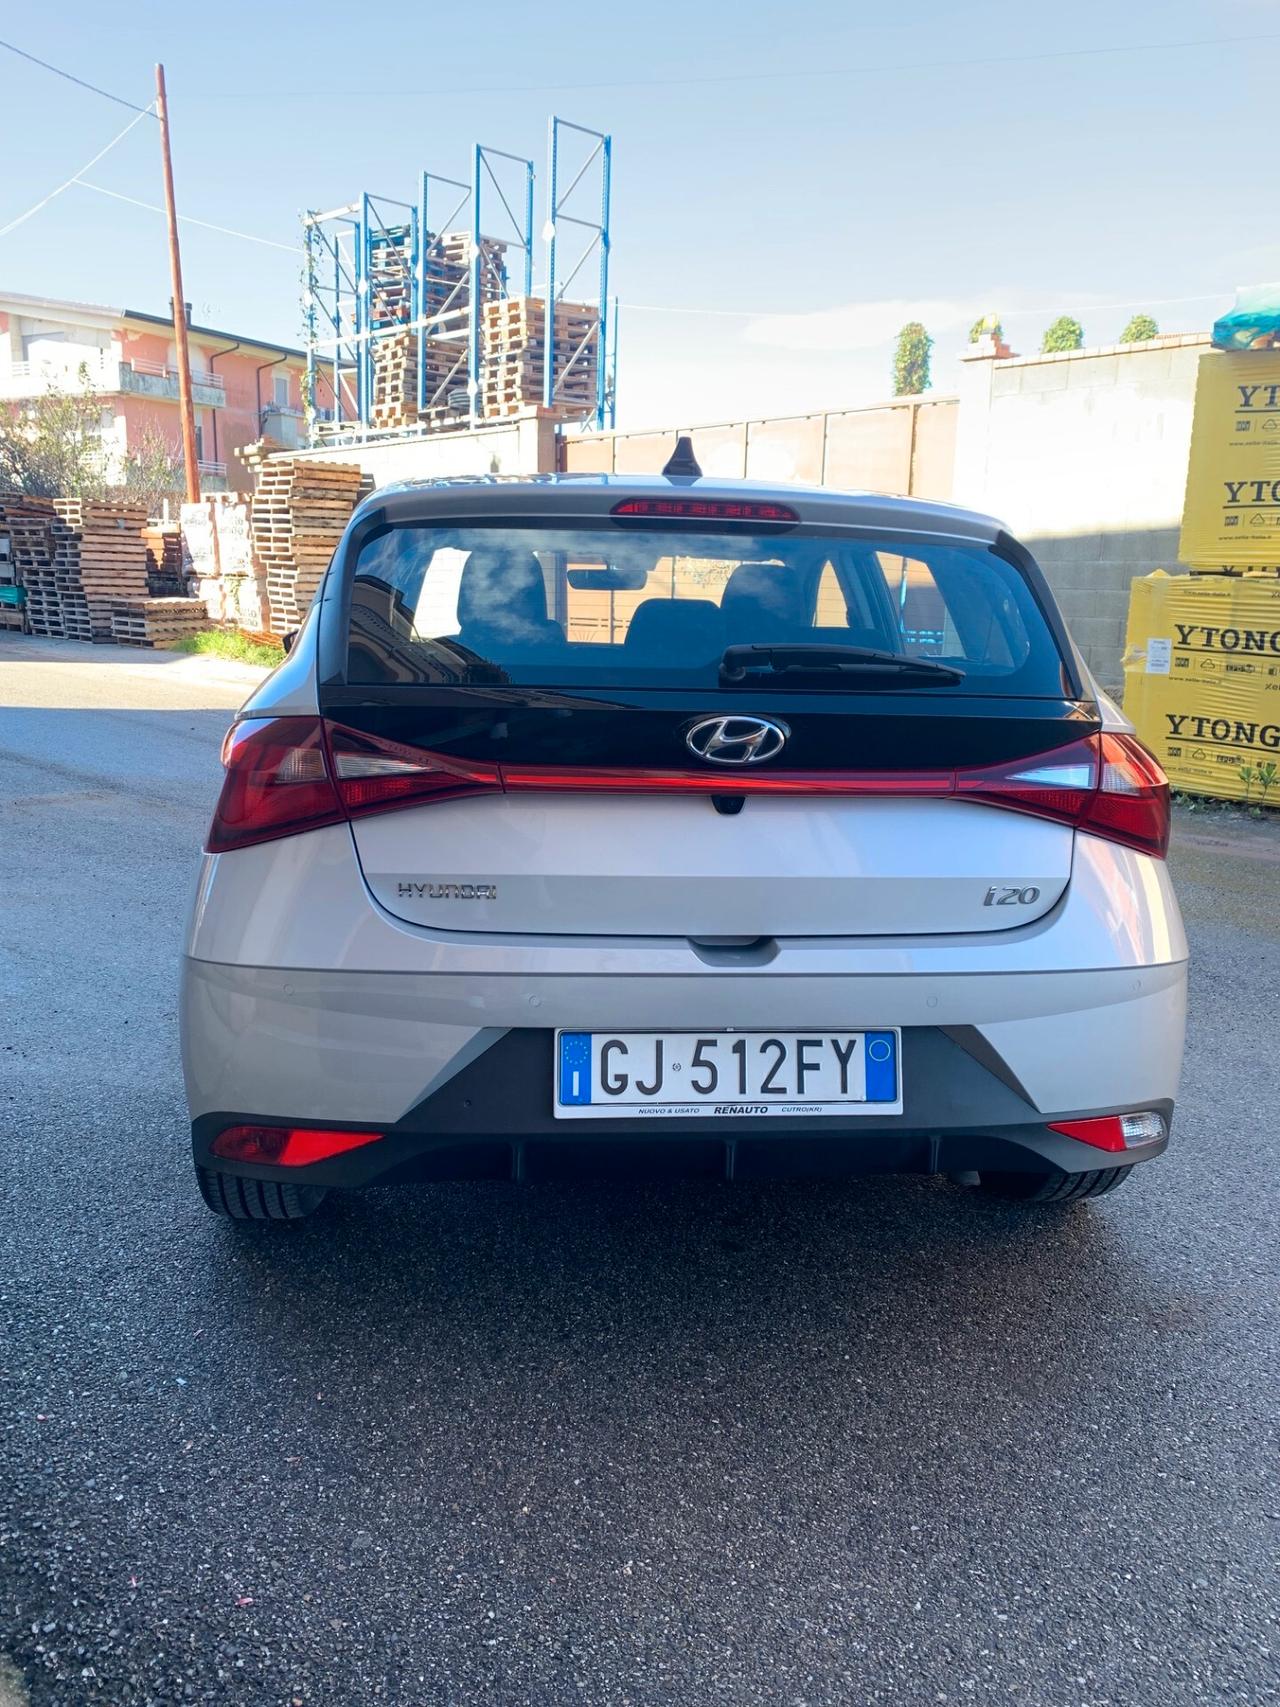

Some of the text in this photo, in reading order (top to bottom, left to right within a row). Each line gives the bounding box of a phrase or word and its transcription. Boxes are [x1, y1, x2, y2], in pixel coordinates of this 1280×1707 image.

[1165, 713, 1280, 748] YTONG
[398, 883, 497, 899] HYUNDAI
[983, 886, 1041, 906] i20
[600, 1038, 857, 1096] GJ 512FY
[713, 1106, 769, 1115] RENAUTO
